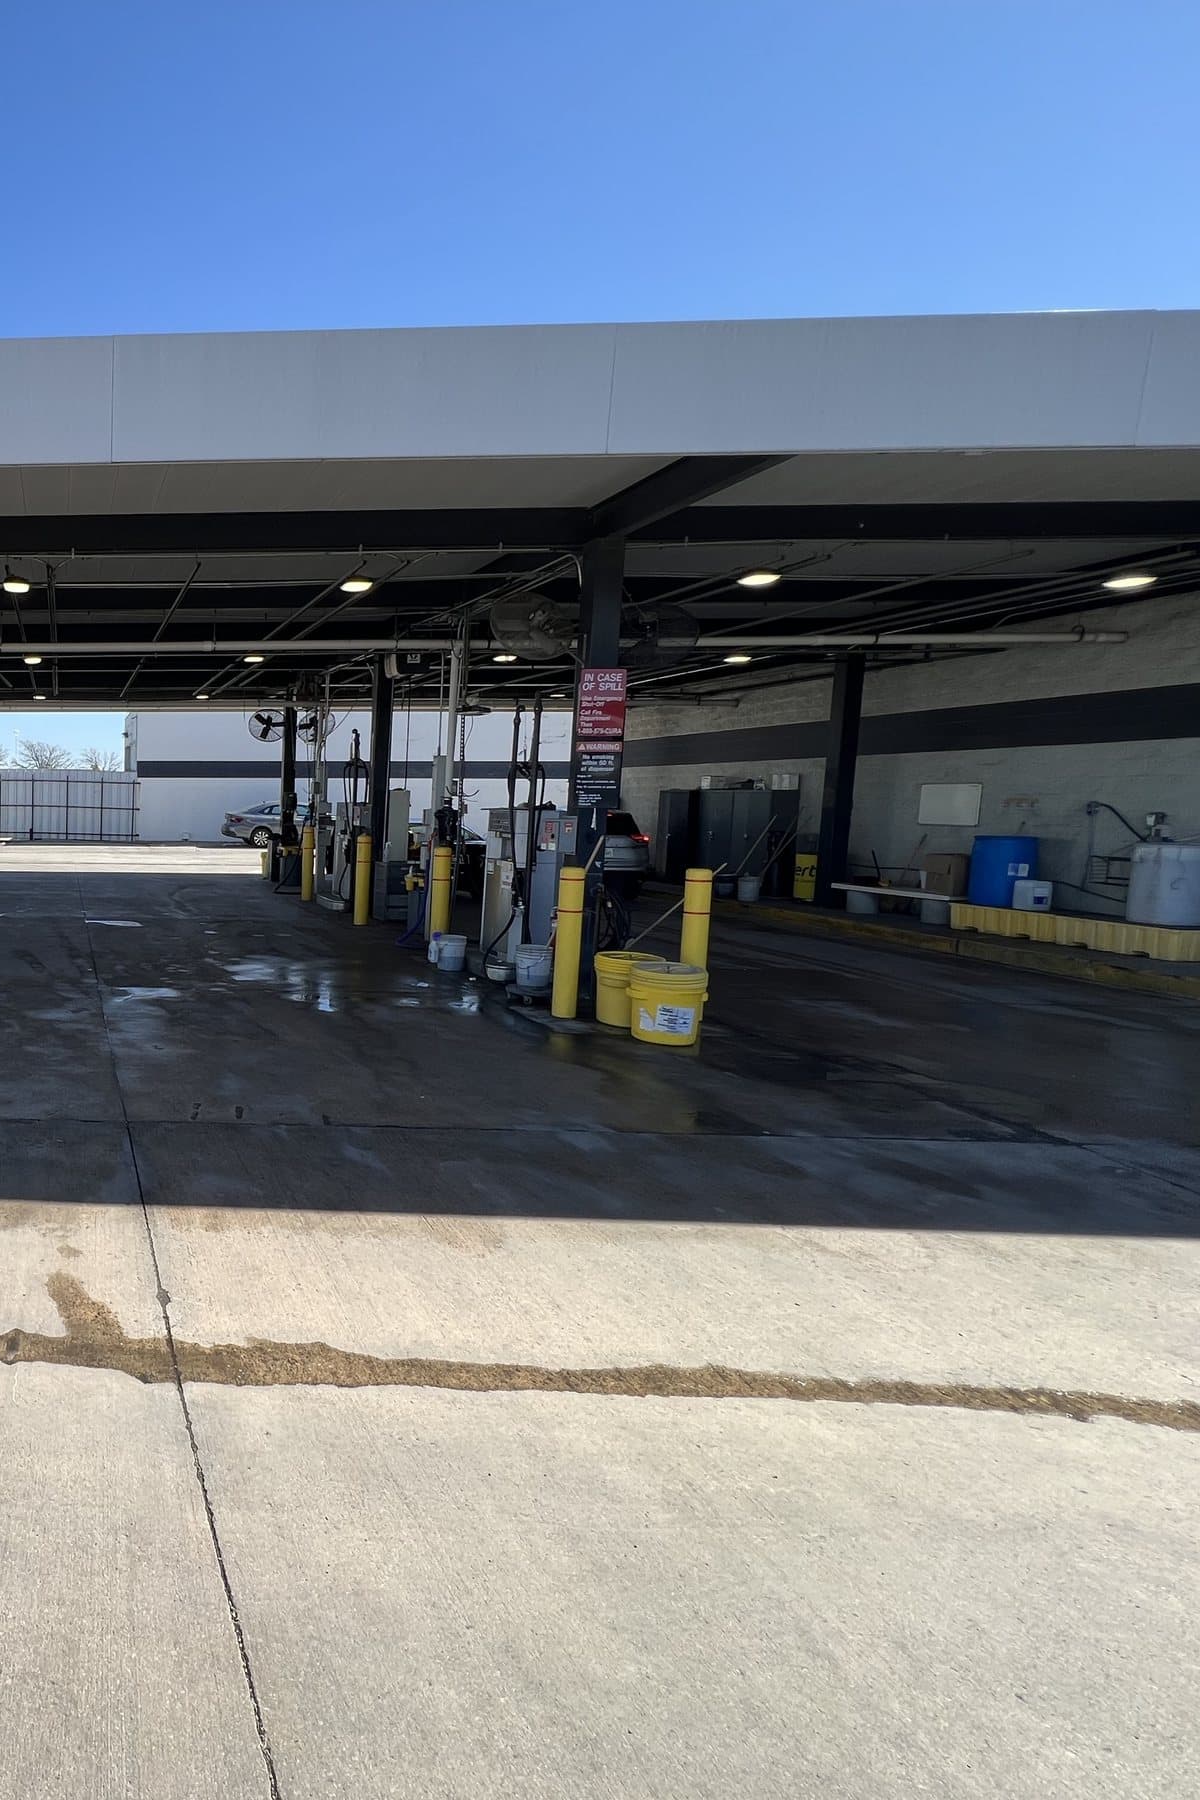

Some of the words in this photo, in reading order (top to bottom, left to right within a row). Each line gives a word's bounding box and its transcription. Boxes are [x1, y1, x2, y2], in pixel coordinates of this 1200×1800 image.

[584, 673, 594, 681] IN
[597, 673, 623, 681] CASE
[582, 682, 596, 691] OF
[598, 682, 624, 691] SPILL
[585, 743, 620, 751] WARNING
